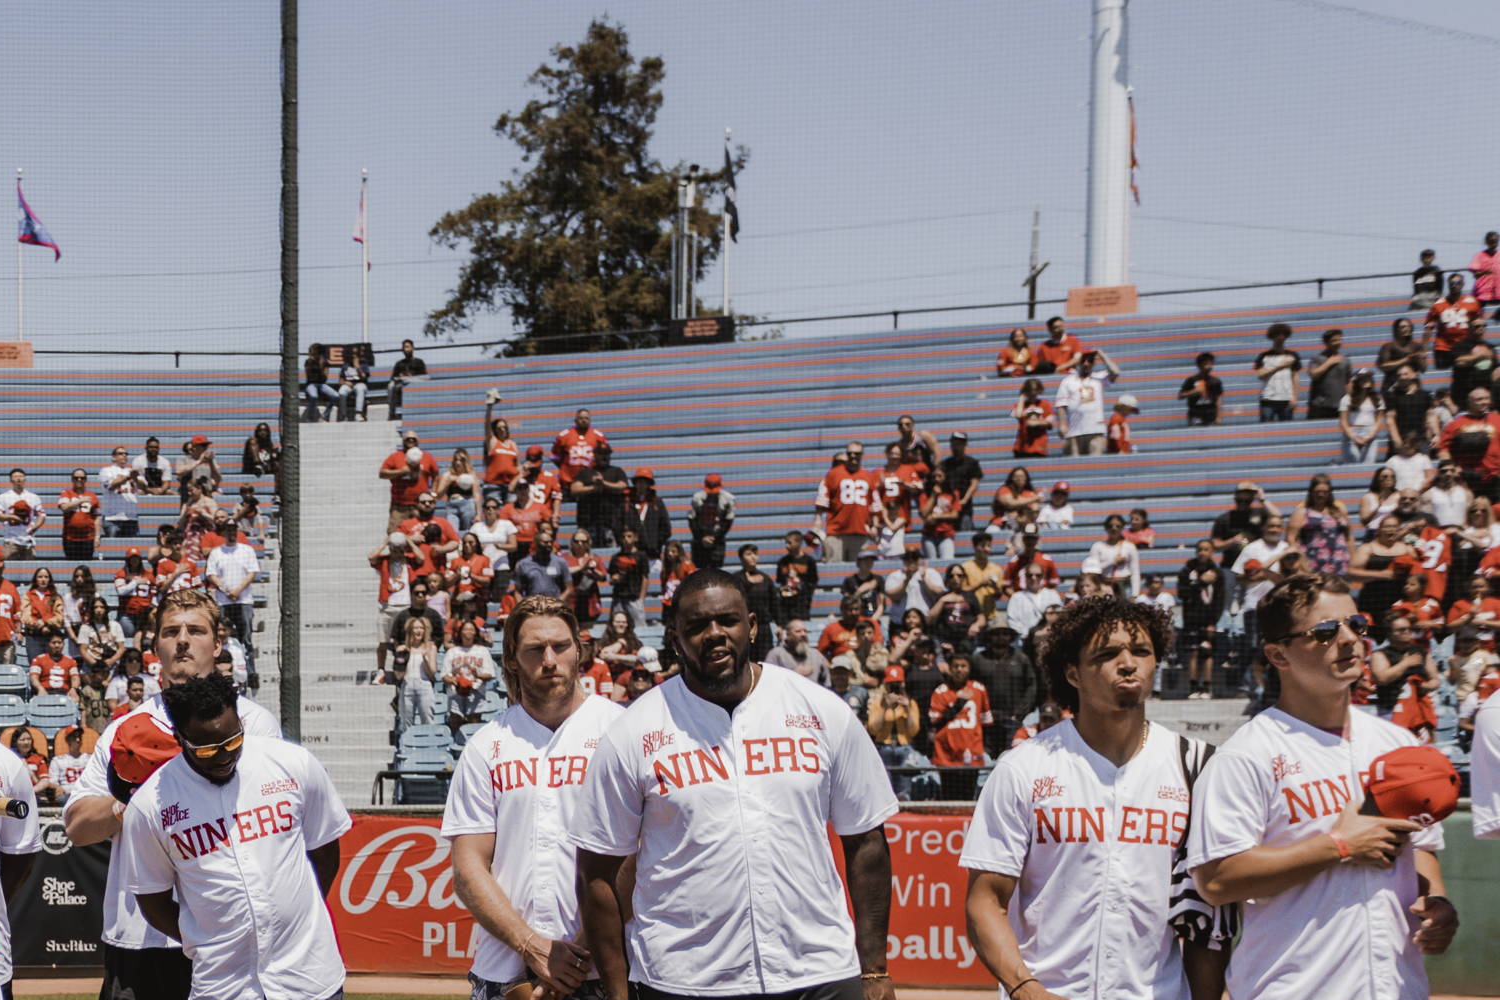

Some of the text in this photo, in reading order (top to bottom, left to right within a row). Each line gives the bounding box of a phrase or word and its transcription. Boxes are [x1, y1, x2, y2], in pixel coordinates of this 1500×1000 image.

[839, 477, 870, 506] 82
[304, 704, 324, 713] ROW
[490, 755, 589, 800] NINER
[653, 737, 821, 796] NINERS
[170, 800, 294, 861] NINERS
[1033, 806, 1189, 849] NINERS
[42, 876, 76, 894] Shoe
[42, 889, 88, 906] Palace
